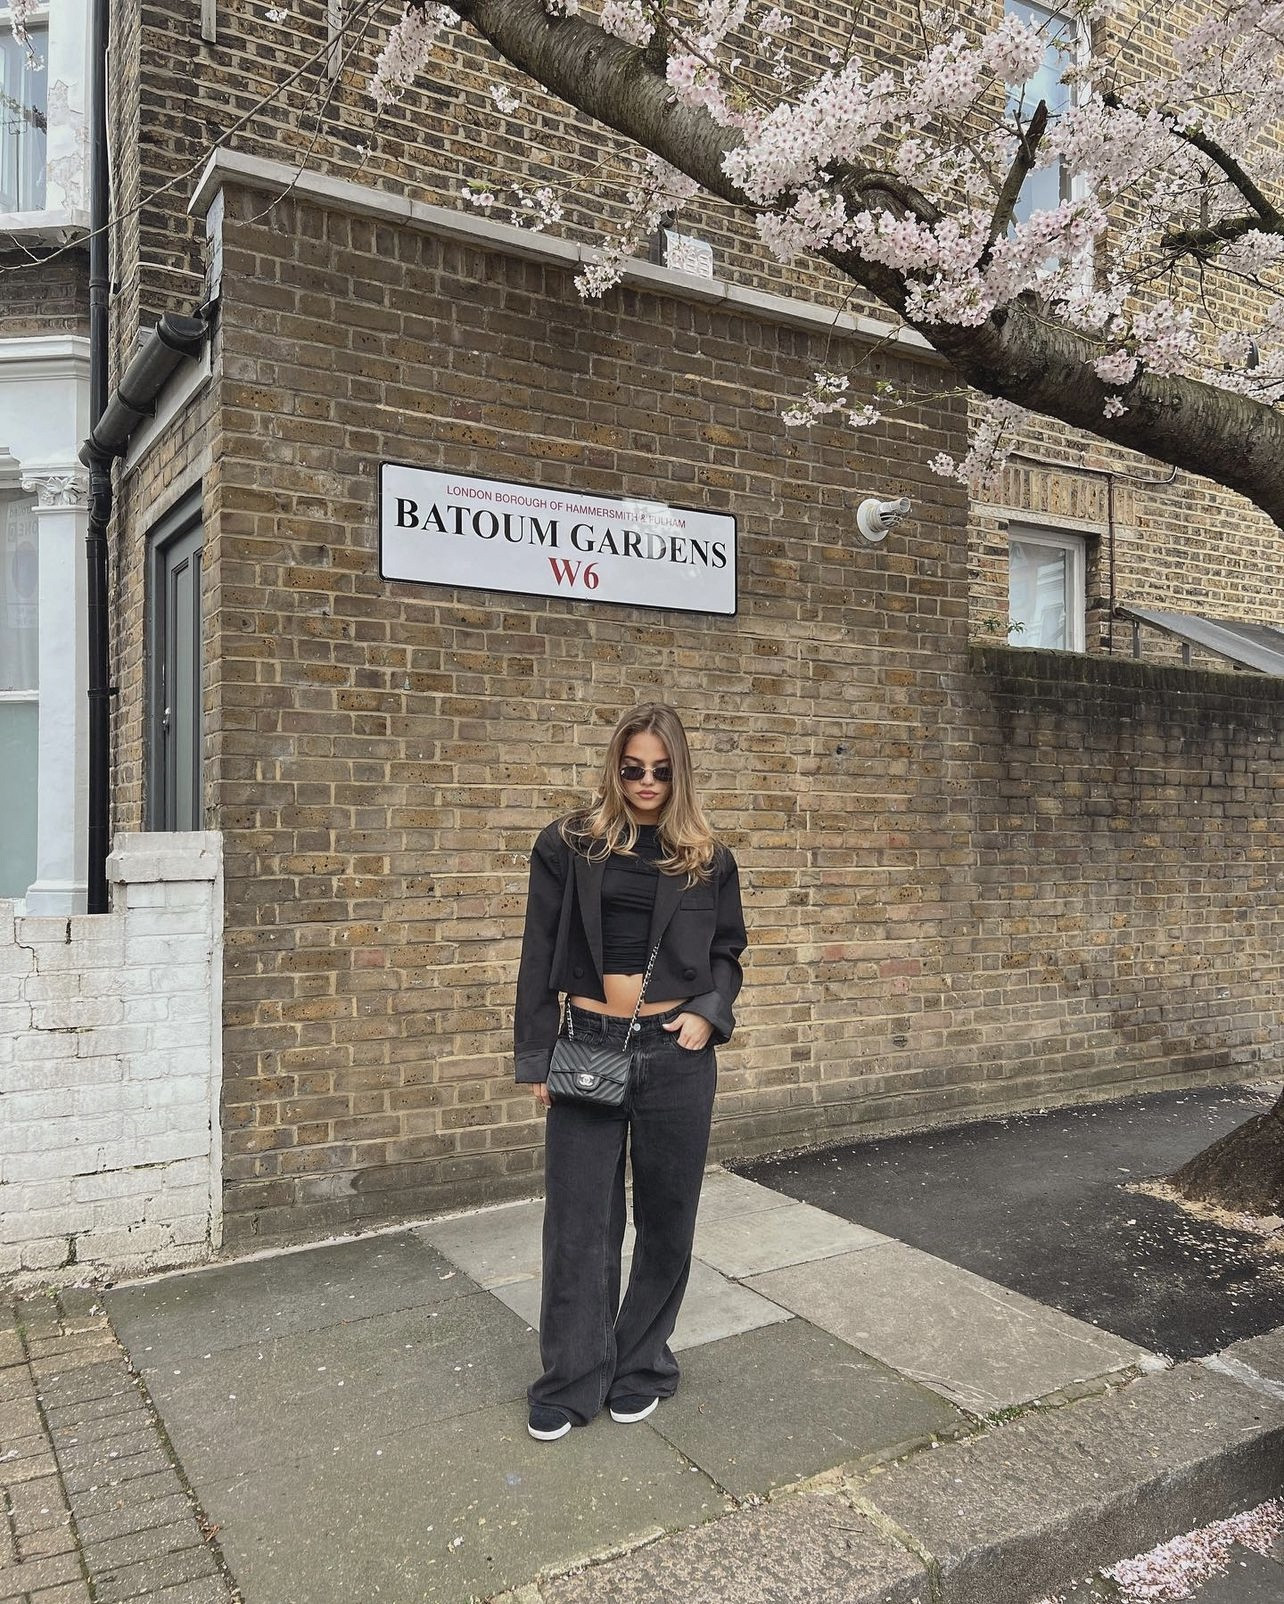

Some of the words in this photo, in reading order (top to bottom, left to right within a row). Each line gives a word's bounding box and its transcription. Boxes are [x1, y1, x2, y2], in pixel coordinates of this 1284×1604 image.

[446, 485, 492, 500] LONDON
[495, 492, 547, 509] BOROUGH
[549, 500, 564, 511] OF
[565, 503, 638, 522] HAMMERSMITH
[640, 513, 646, 523] &
[648, 514, 686, 529] FULHAM
[394, 497, 560, 548] BATOUM
[570, 523, 727, 569] GARDENS
[548, 557, 599, 590] W6
